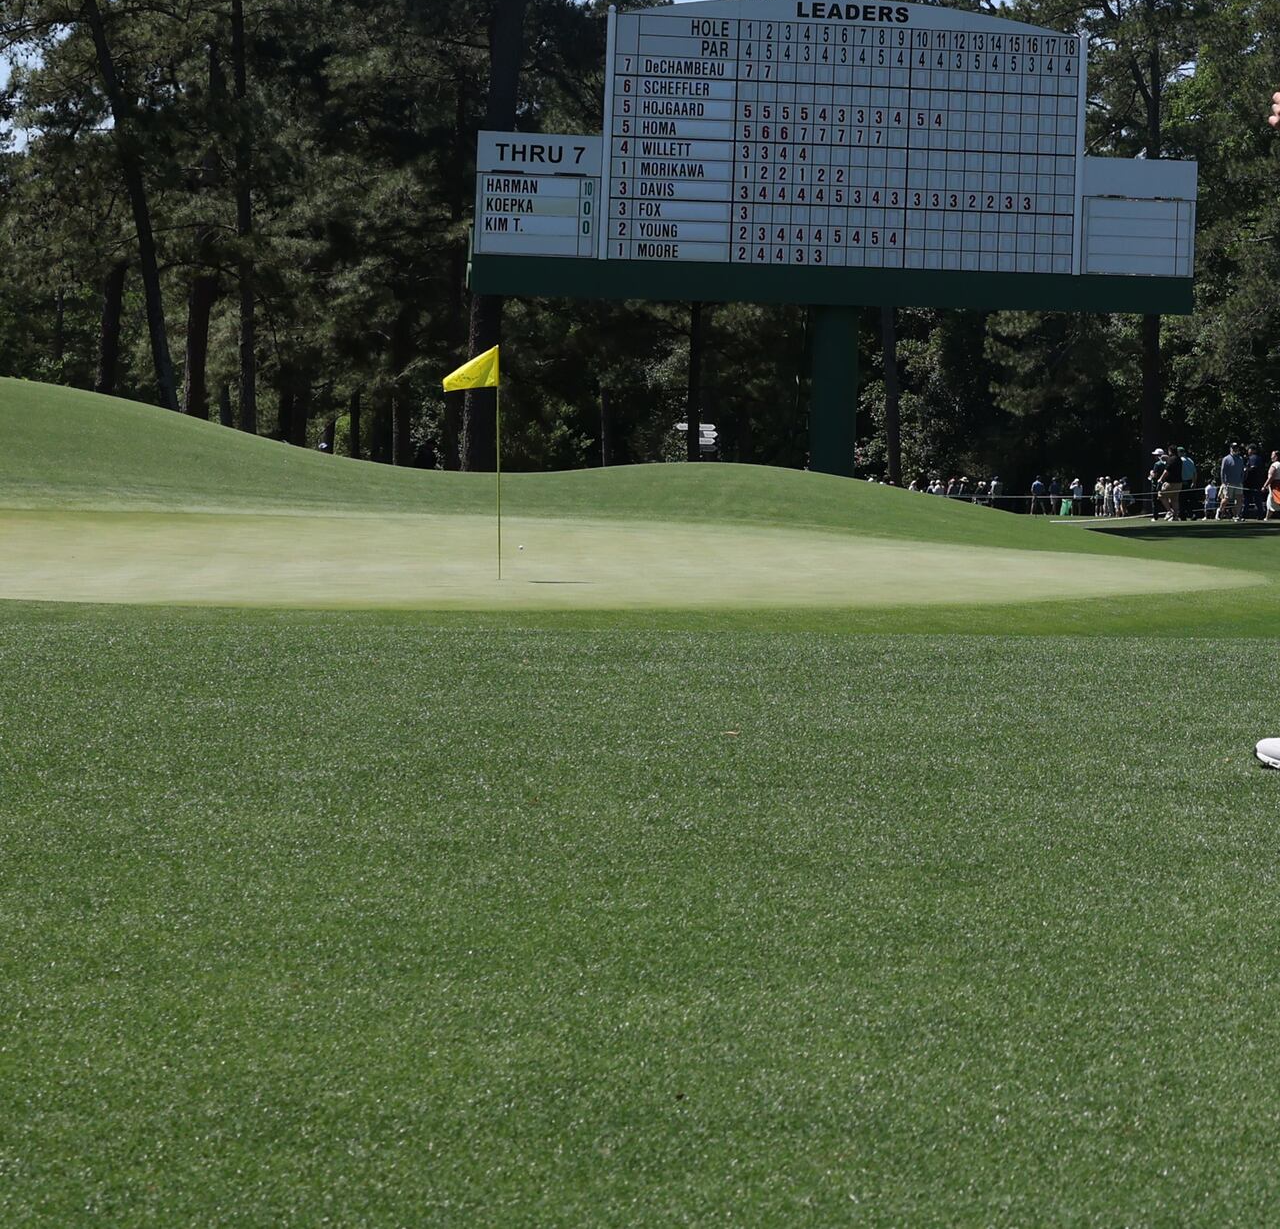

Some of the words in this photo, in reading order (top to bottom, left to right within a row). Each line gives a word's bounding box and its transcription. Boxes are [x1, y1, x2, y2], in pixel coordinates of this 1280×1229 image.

[797, 1, 909, 23] LEADERS
[691, 19, 729, 37] HOLE
[747, 22, 752, 39] 1
[766, 23, 773, 40] 2
[785, 24, 791, 41] 3
[804, 25, 811, 41] 4
[823, 26, 830, 43] 5
[841, 27, 848, 44] 6
[860, 28, 867, 44] 7
[879, 29, 885, 45] 8
[898, 30, 905, 46] 9
[916, 31, 928, 48] 10
[936, 32, 946, 48] 11
[954, 33, 965, 50] 12
[972, 34, 984, 51] 13
[990, 35, 1002, 51] 14
[1009, 36, 1020, 53] 15
[1026, 37, 1038, 54] 16
[1045, 38, 1057, 54] 17
[1063, 39, 1076, 55] 18
[701, 40, 728, 57] PAR
[745, 42, 752, 59] 4
[766, 43, 772, 60] 5
[784, 44, 791, 61] 4
[804, 45, 810, 62] 3
[822, 46, 829, 63] 4
[840, 47, 847, 63] 3
[859, 48, 866, 64] 4
[878, 49, 885, 65] 5
[897, 50, 904, 66] 4
[918, 51, 925, 67] 4
[937, 52, 944, 68] 4
[956, 53, 962, 69] 3
[974, 54, 981, 70] 5
[992, 55, 998, 71] 4
[1011, 55, 1017, 72] 5
[1028, 56, 1035, 73] 3
[1047, 57, 1053, 73] 4
[1065, 59, 1071, 75] 4
[625, 58, 631, 72] 7
[645, 59, 724, 77] DeCHAMBEAU
[745, 64, 753, 78] 7
[764, 65, 771, 79] 7
[623, 79, 631, 93] 6
[644, 80, 710, 97] SCHEFFLER
[623, 99, 631, 114] 5
[643, 100, 704, 117] HOJGAARD
[744, 104, 752, 119] 5
[763, 105, 771, 119] 5
[782, 106, 789, 120] 5
[800, 107, 808, 121] 5
[818, 108, 827, 122] 4
[838, 109, 845, 123] 3
[857, 109, 864, 124] 3
[875, 110, 882, 124] 3
[894, 111, 901, 125] 4
[917, 113, 925, 126] 5
[934, 113, 942, 127] 4
[622, 119, 630, 134] 5
[642, 120, 676, 136] HOMA
[743, 125, 751, 139] 5
[761, 125, 770, 140] 6
[780, 126, 788, 140] 6
[800, 127, 807, 141] 7
[819, 128, 826, 142] 7
[838, 129, 845, 143] 7
[857, 129, 863, 144] 7
[875, 130, 882, 144] 7
[495, 143, 563, 164] THRU
[573, 146, 586, 164] 7
[620, 140, 628, 154] 4
[642, 141, 692, 157] WILLETT
[742, 145, 750, 159] 3
[761, 146, 768, 160] 3
[779, 146, 787, 161] 4
[799, 147, 807, 161] 4
[622, 161, 626, 175] 1
[640, 162, 704, 178] MORIKAWA
[744, 165, 748, 179] 1
[760, 165, 768, 180] 2
[778, 166, 787, 181] 2
[800, 167, 805, 182] 1
[817, 168, 825, 182] 2
[836, 169, 844, 183] 2
[487, 178, 538, 194] HARMAN
[584, 181, 593, 196] 10
[619, 181, 627, 196] 3
[640, 182, 674, 197] DAVIS
[740, 185, 749, 200] 3
[759, 186, 767, 200] 4
[778, 186, 786, 201] 4
[797, 187, 806, 202] 4
[815, 188, 824, 202] 4
[835, 189, 843, 203] 5
[854, 190, 861, 204] 3
[872, 191, 880, 205] 4
[891, 191, 899, 206] 3
[914, 192, 921, 207] 3
[932, 193, 939, 207] 3
[949, 194, 957, 208] 3
[968, 194, 976, 208] 2
[986, 195, 994, 209] 2
[1005, 196, 1013, 210] 3
[1023, 196, 1031, 211] 3
[486, 197, 533, 213] KOEPKA
[583, 201, 591, 215] 0
[619, 201, 626, 216] 3
[639, 202, 661, 217] FOX
[740, 206, 748, 220] 3
[485, 216, 508, 232] KIM
[512, 218, 523, 232] T.
[582, 220, 590, 234] 0
[618, 221, 626, 236] 2
[639, 222, 678, 238] YOUNG
[739, 226, 747, 240] 2
[758, 227, 766, 241] 3
[777, 228, 785, 242] 4
[796, 228, 803, 242] 4
[814, 229, 822, 243] 4
[834, 229, 841, 244] 5
[852, 230, 861, 244] 4
[871, 231, 879, 245] 5
[889, 232, 897, 246] 4
[618, 242, 623, 257] 1
[637, 242, 679, 258] MOORE
[738, 246, 746, 260] 2
[757, 247, 765, 261] 4
[776, 248, 783, 262] 4
[795, 248, 804, 263] 3
[814, 249, 822, 263] 3
